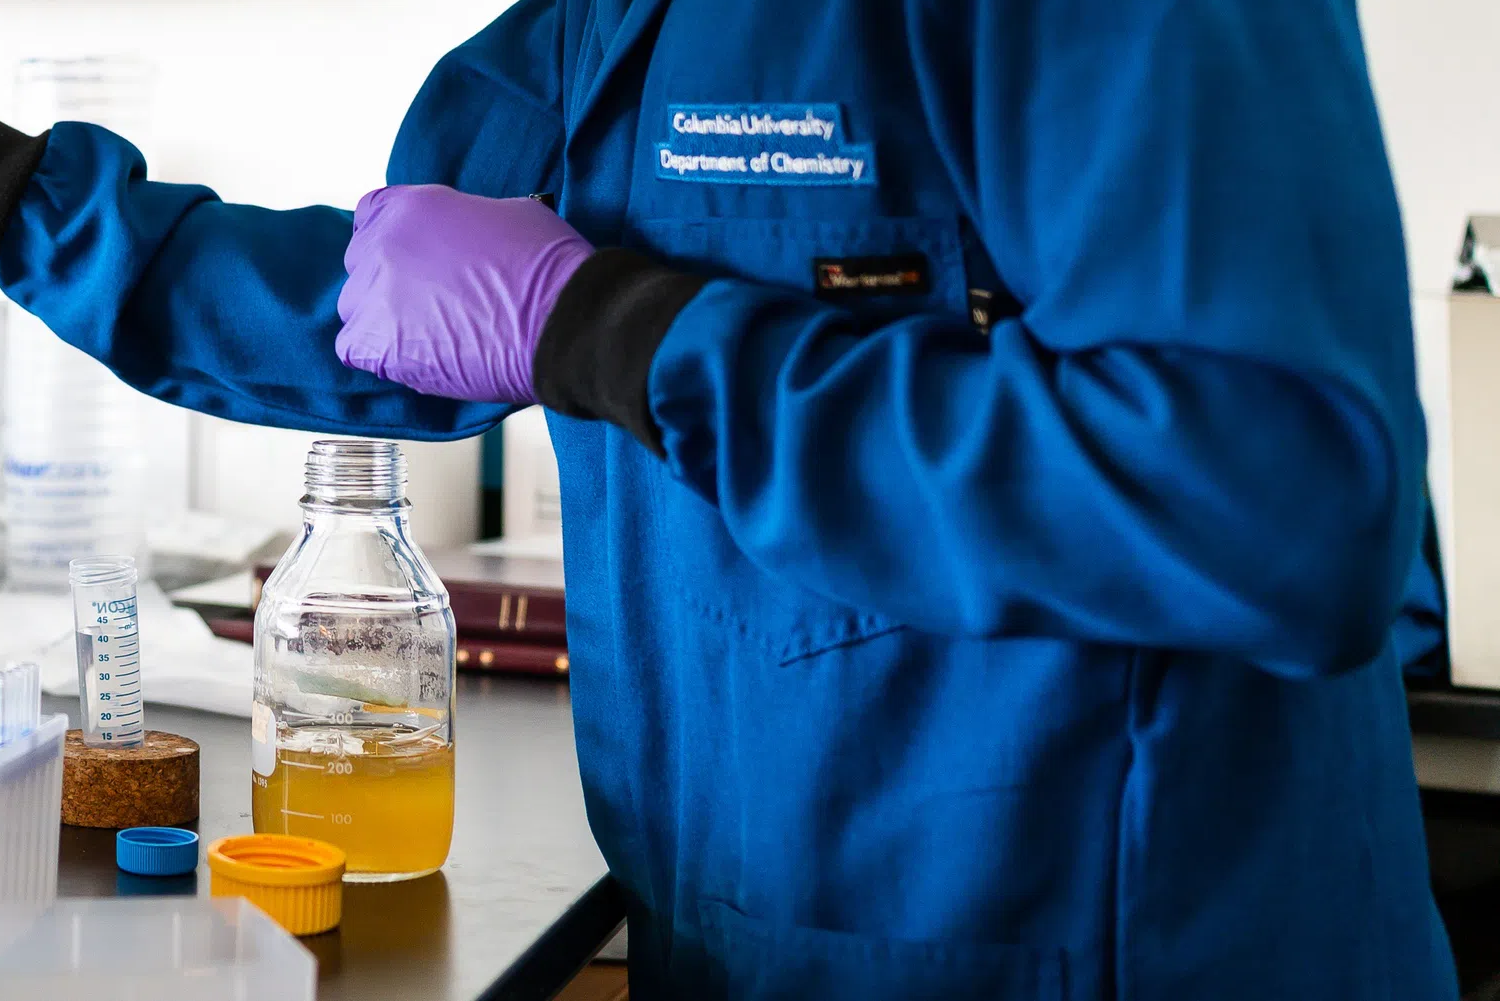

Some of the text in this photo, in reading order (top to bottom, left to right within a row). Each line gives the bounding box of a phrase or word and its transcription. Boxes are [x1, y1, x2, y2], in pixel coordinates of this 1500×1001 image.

[673, 109, 835, 141] Columbia University
[660, 149, 864, 180] Department of Chemistry
[96, 616, 108, 624] 45
[97, 635, 109, 643] 40
[98, 654, 110, 662] 35
[329, 713, 354, 725] 300
[101, 732, 113, 741] 15
[327, 762, 353, 775] 200
[331, 814, 353, 825] 100
